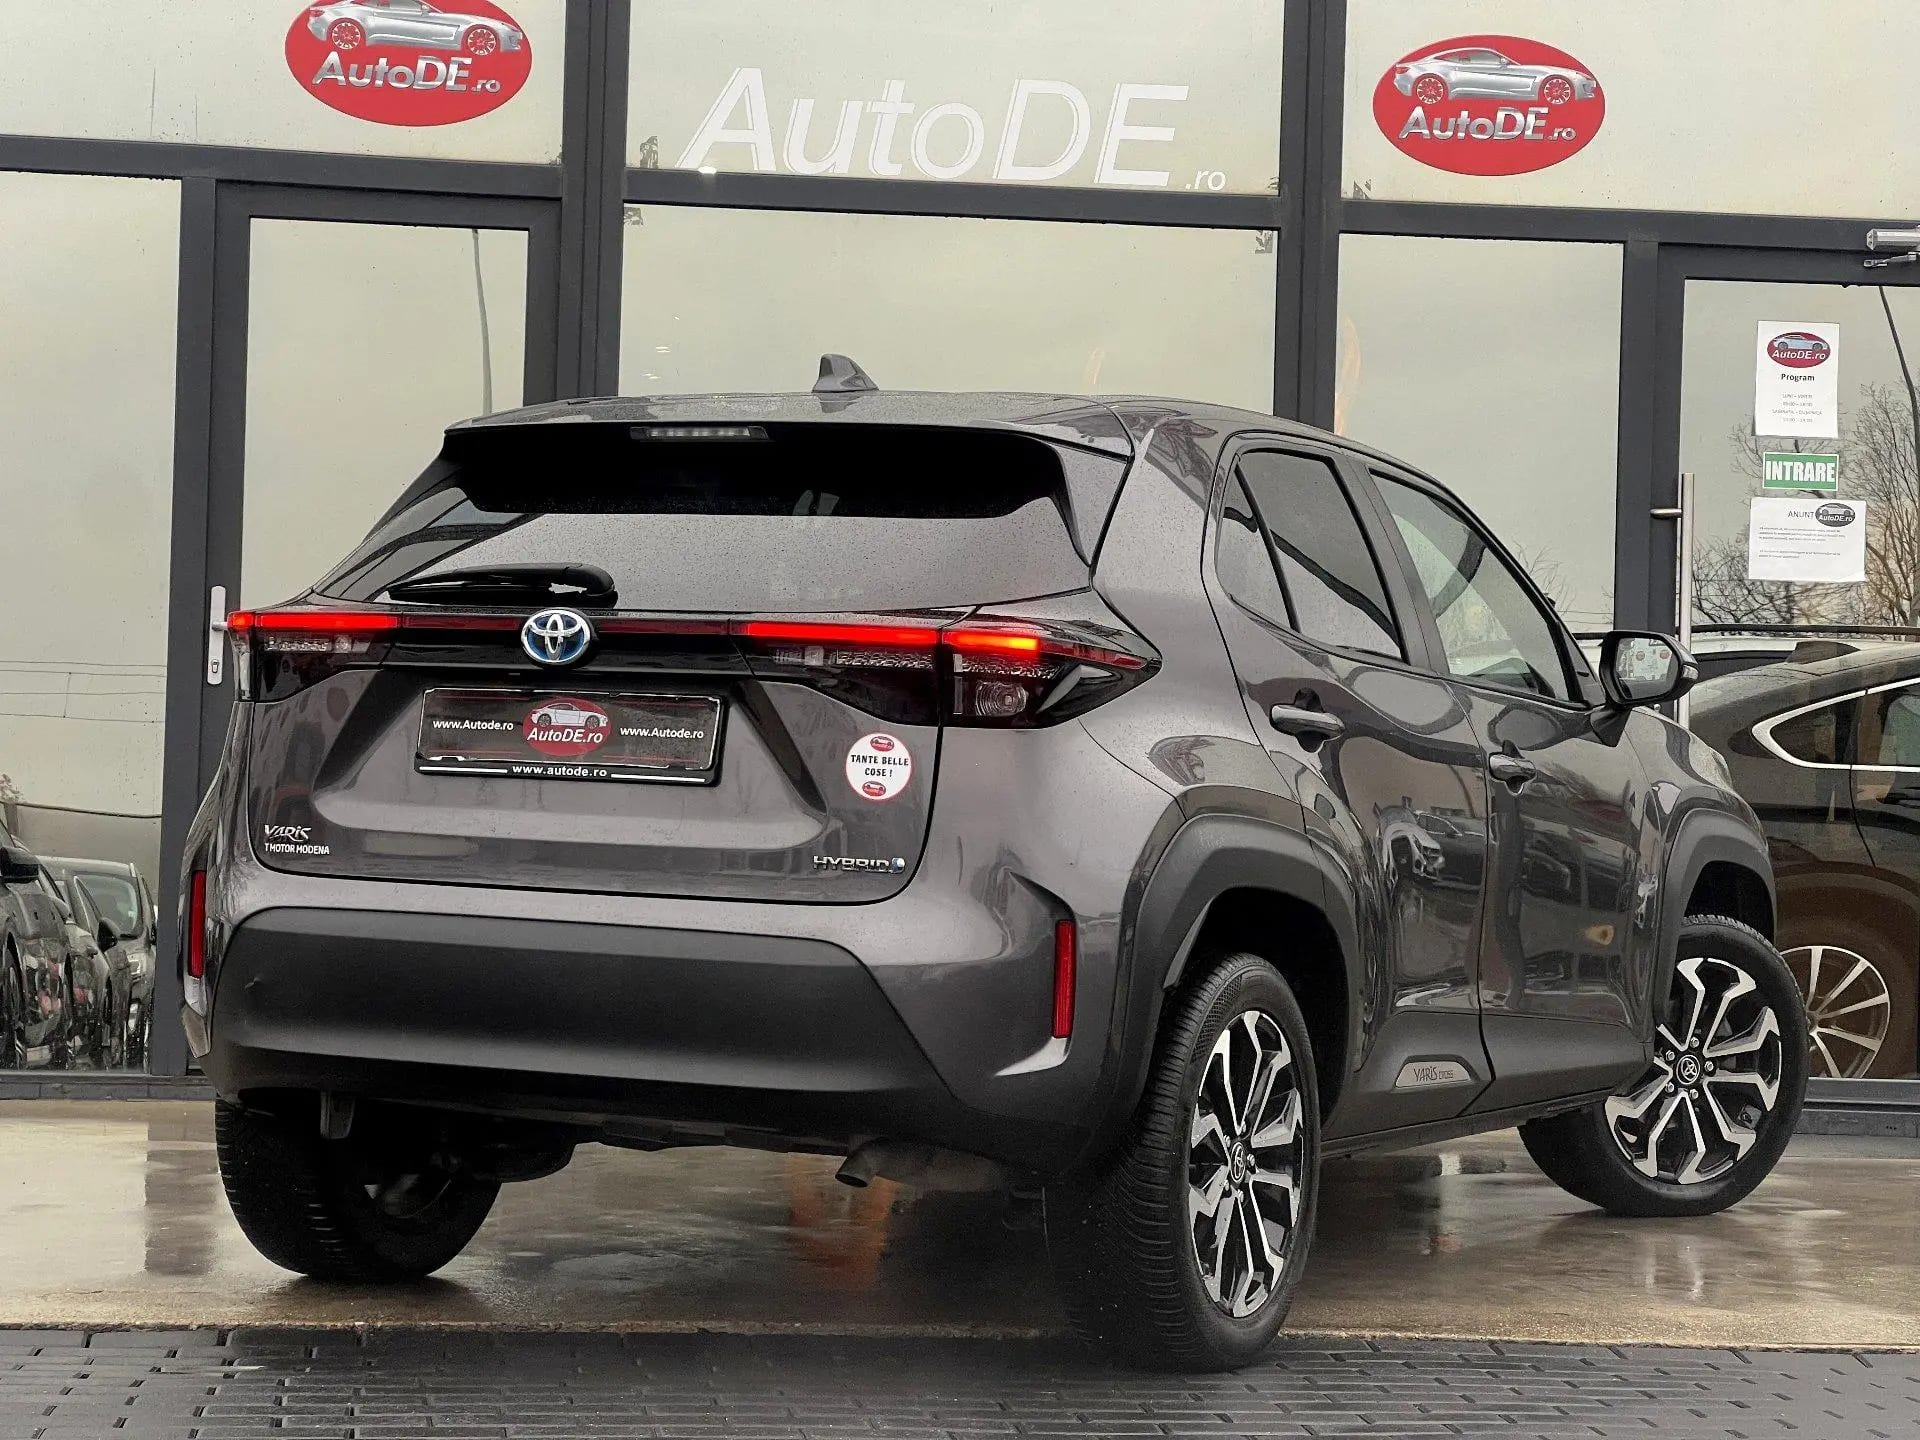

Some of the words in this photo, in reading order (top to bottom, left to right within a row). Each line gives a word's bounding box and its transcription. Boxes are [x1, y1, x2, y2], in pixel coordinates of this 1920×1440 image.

[1781, 373, 1815, 382] Program
[1765, 460, 1836, 482] INTRARE
[432, 719, 514, 731] www.Autode.ro
[526, 727, 604, 744] AutoDE.ro
[620, 726, 704, 740] www.Autode.ro
[851, 754, 879, 765] TANTE
[881, 756, 909, 767] BELLE
[512, 765, 607, 778] www.autode.ro
[864, 767, 887, 777] COSE
[270, 843, 295, 853] MOTOR
[296, 844, 330, 855] MODENA
[813, 855, 891, 873] HYBRID
